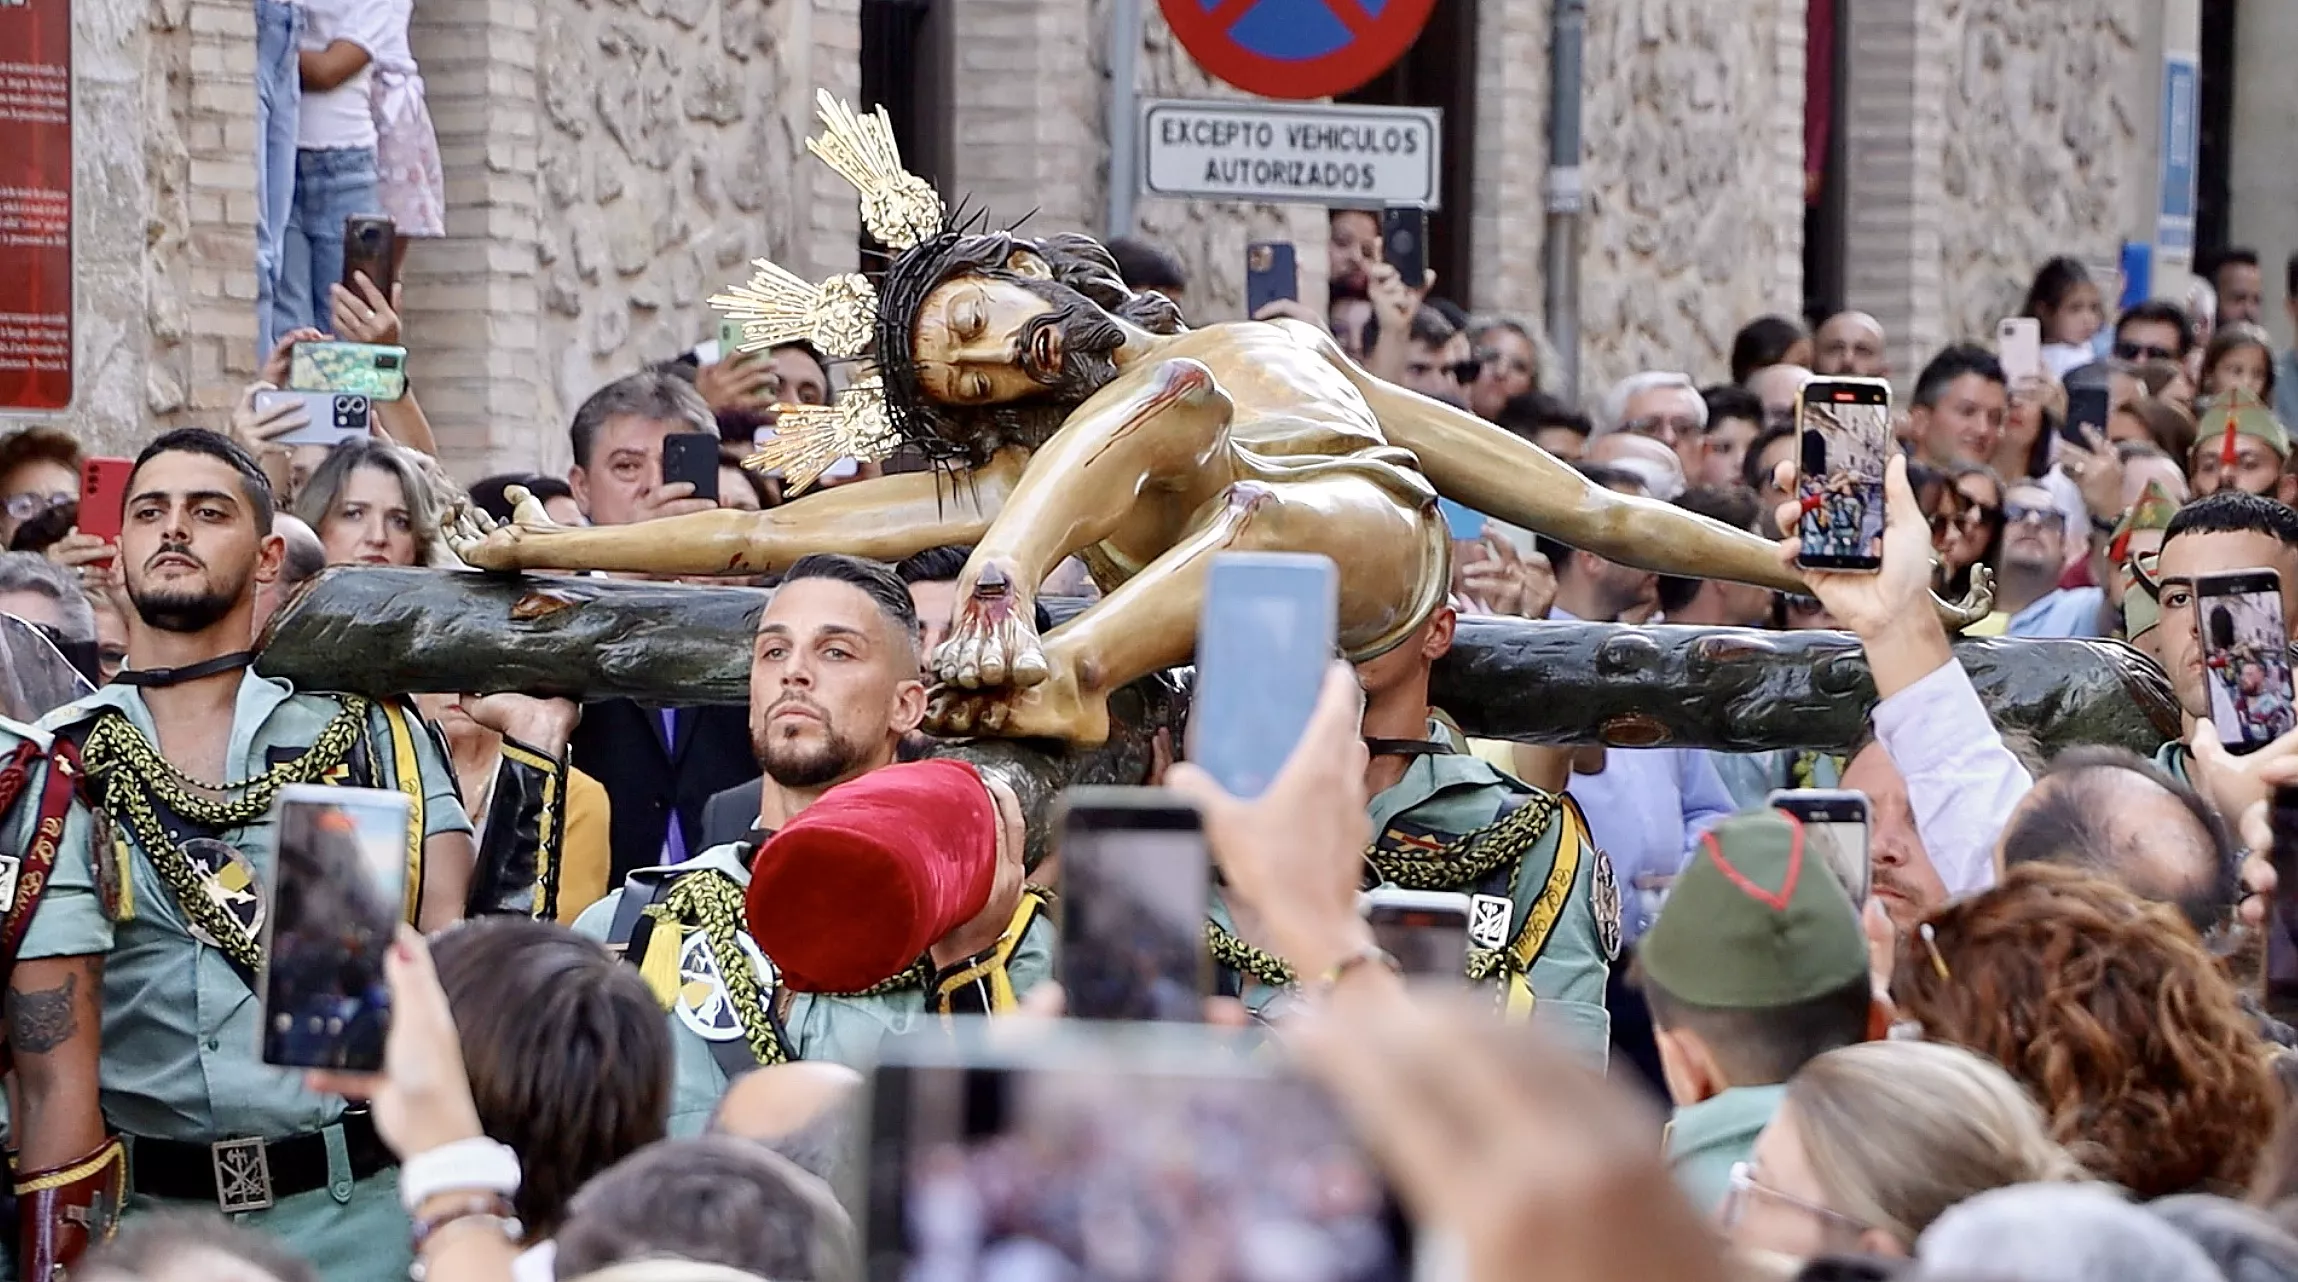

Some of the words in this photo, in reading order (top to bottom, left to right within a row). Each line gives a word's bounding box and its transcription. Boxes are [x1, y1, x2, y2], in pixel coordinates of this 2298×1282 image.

[1161, 118, 1273, 147] EXCEPTO
[1287, 123, 1418, 155] VEHICULOS
[1204, 158, 1375, 190] AUTORIZADOS
